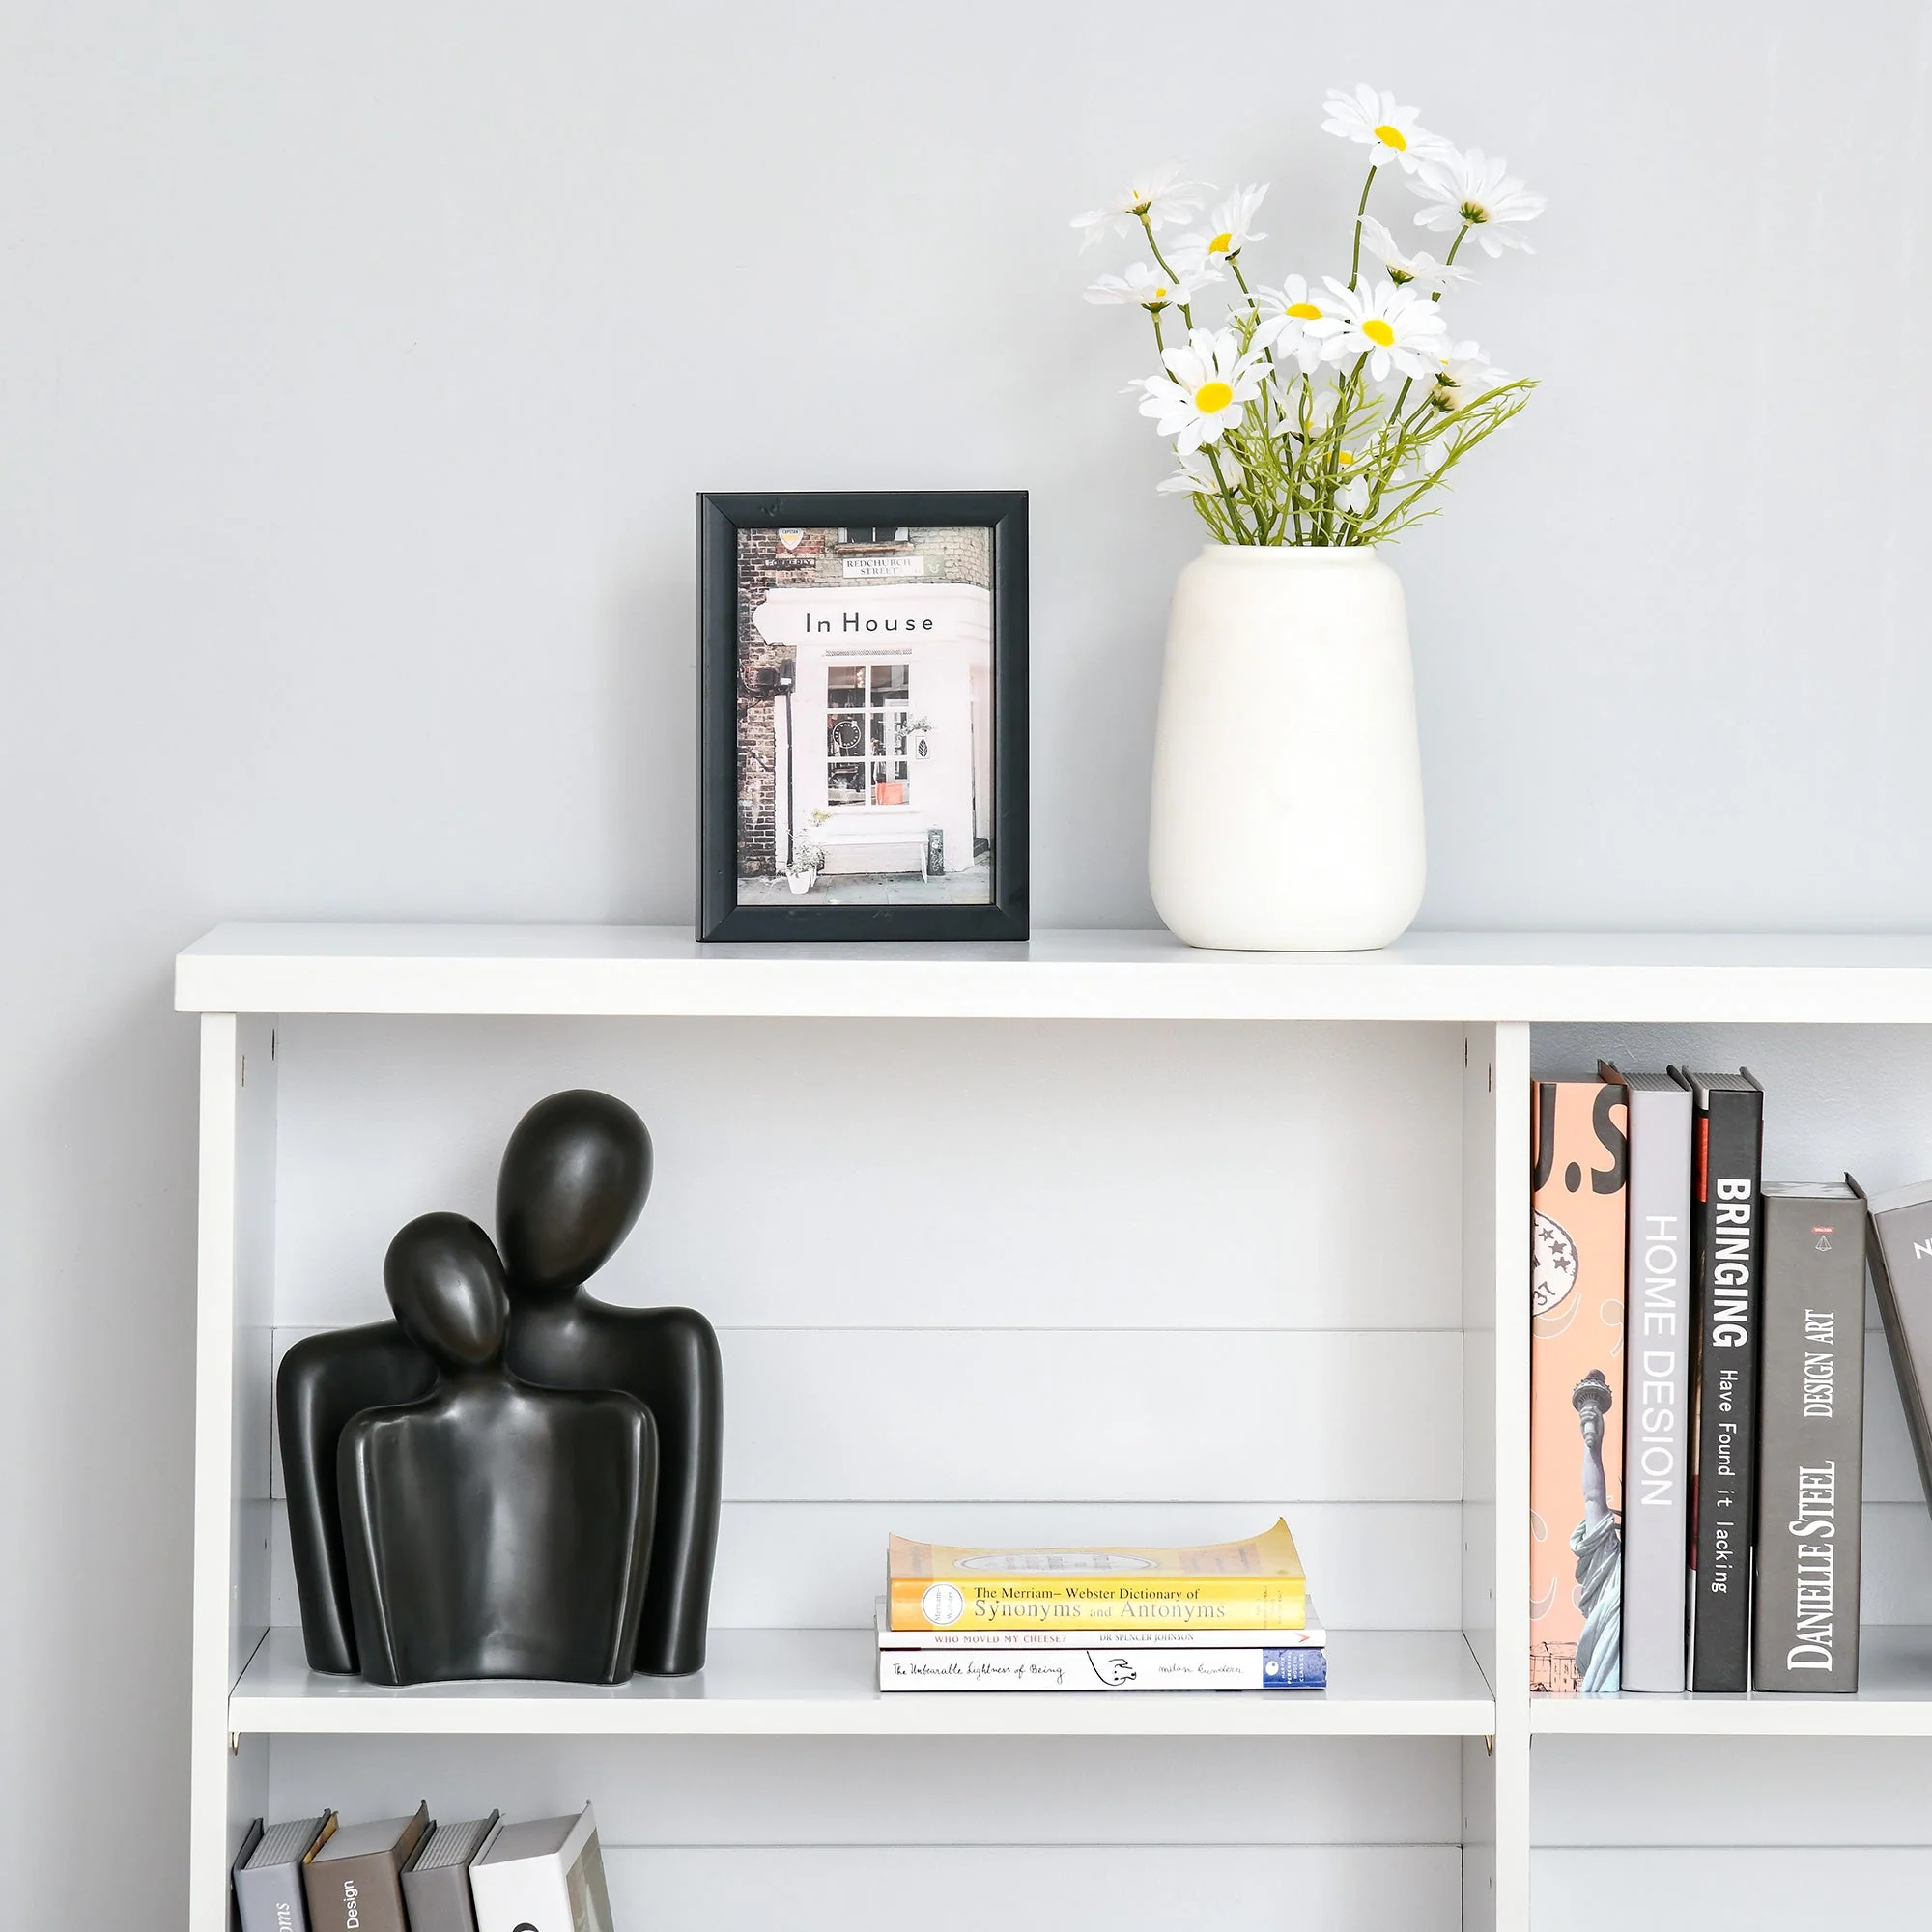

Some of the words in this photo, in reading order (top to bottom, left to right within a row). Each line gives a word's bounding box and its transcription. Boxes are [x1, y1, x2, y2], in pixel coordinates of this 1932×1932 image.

[846, 558, 912, 568] REDCHURCH
[860, 567, 897, 576] STREET
[806, 613, 831, 633] In
[843, 612, 933, 632] House
[1643, 1215, 1678, 1336] HOME
[1712, 1178, 1751, 1348] BRINGING
[1804, 1308, 1834, 1346] ART
[1718, 1369, 1739, 1412] Have
[1804, 1352, 1834, 1418] DESIGN
[1640, 1351, 1675, 1506] DESIGN
[1715, 1423, 1737, 1477] Found
[1716, 1489, 1735, 1508] it
[1788, 1460, 1836, 1539] STEEL
[1711, 1521, 1734, 1594] lacking
[974, 1587, 997, 1599] The
[1065, 1587, 1117, 1599] Webster
[1120, 1587, 1182, 1602] Dictionary
[1186, 1588, 1201, 1599] of
[974, 1599, 1082, 1622] Synonyms
[1090, 1607, 1112, 1618] and
[1121, 1601, 1226, 1622] Antonyms
[1787, 1543, 1834, 1672] DANIELLE
[1099, 1634, 1113, 1642] DR
[1115, 1634, 1152, 1642] SPENCER
[1154, 1634, 1194, 1643] JOHNSON
[893, 1663, 907, 1676] The
[910, 1663, 963, 1676] Unbearable
[966, 1661, 1010, 1681] Lightness
[1013, 1664, 1026, 1679] of
[1029, 1664, 1065, 1684] Being
[343, 1880, 360, 1929] Design
